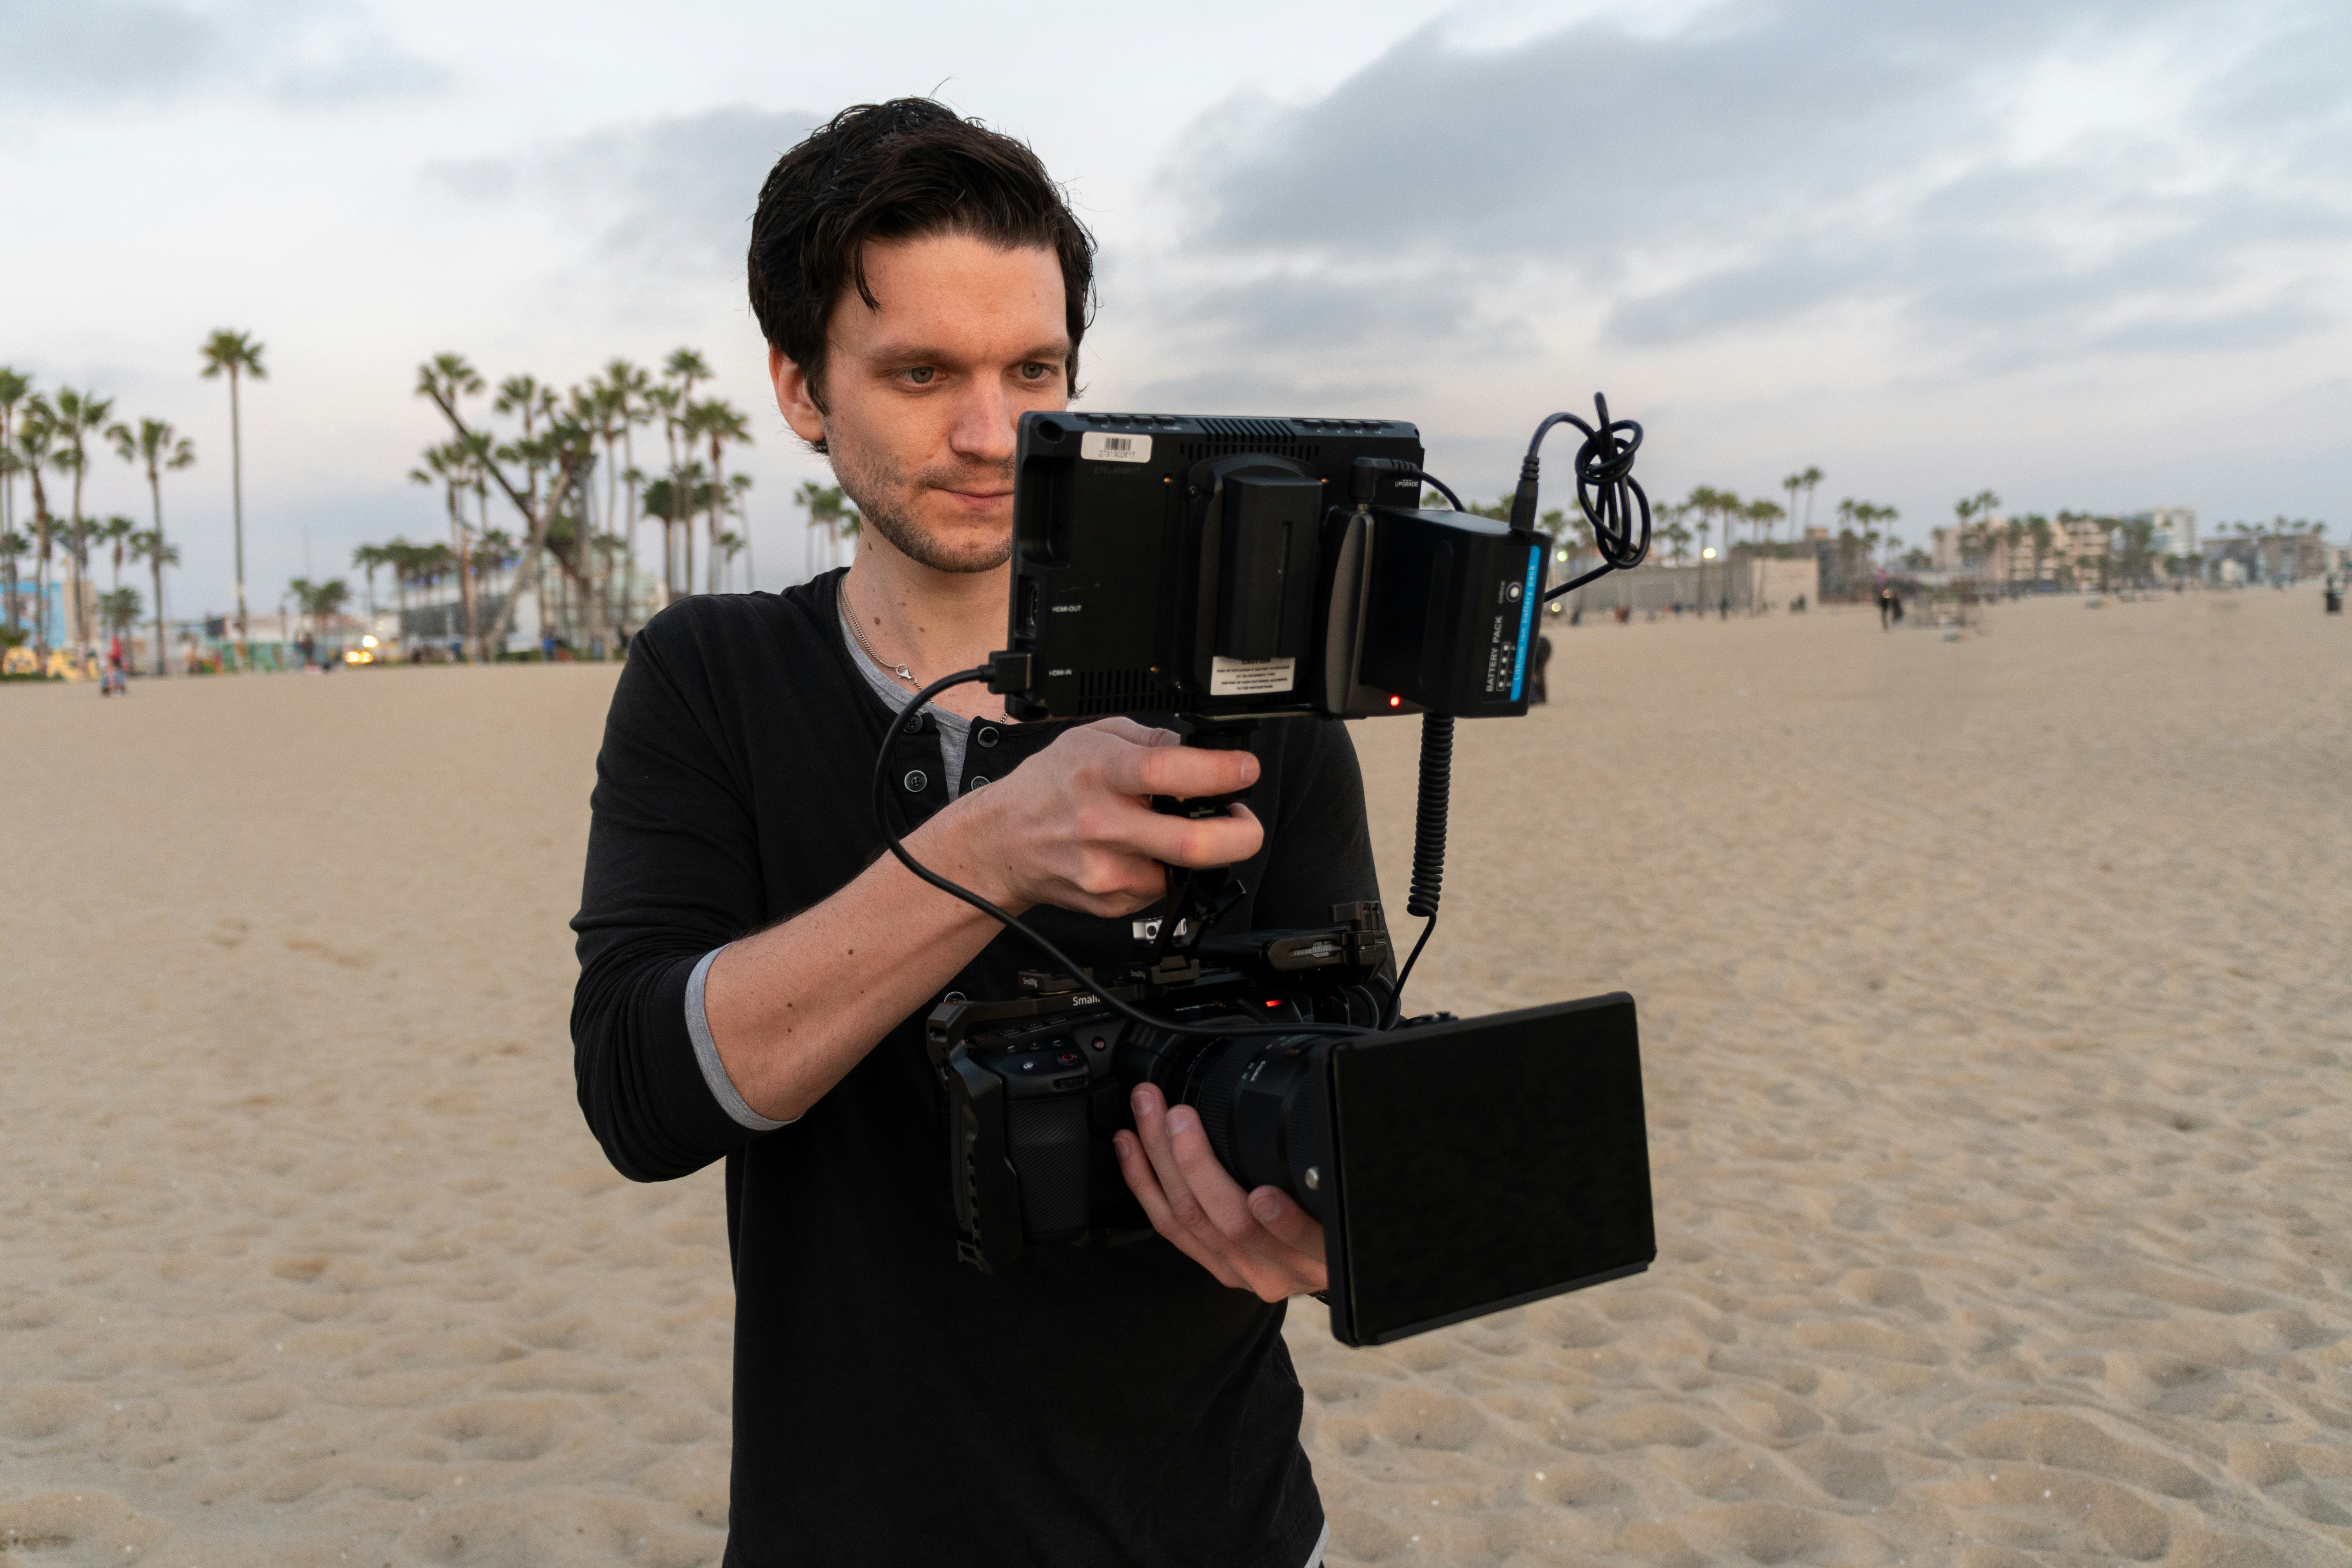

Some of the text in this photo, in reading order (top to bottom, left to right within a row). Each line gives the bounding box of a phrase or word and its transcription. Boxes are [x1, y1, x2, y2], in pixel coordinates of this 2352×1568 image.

[1486, 615, 1503, 692] BATTERY PACK
[1514, 647, 1524, 680] Lithium
[1521, 592, 1533, 623] battery
[1130, 970, 1146, 980] SmallRig
